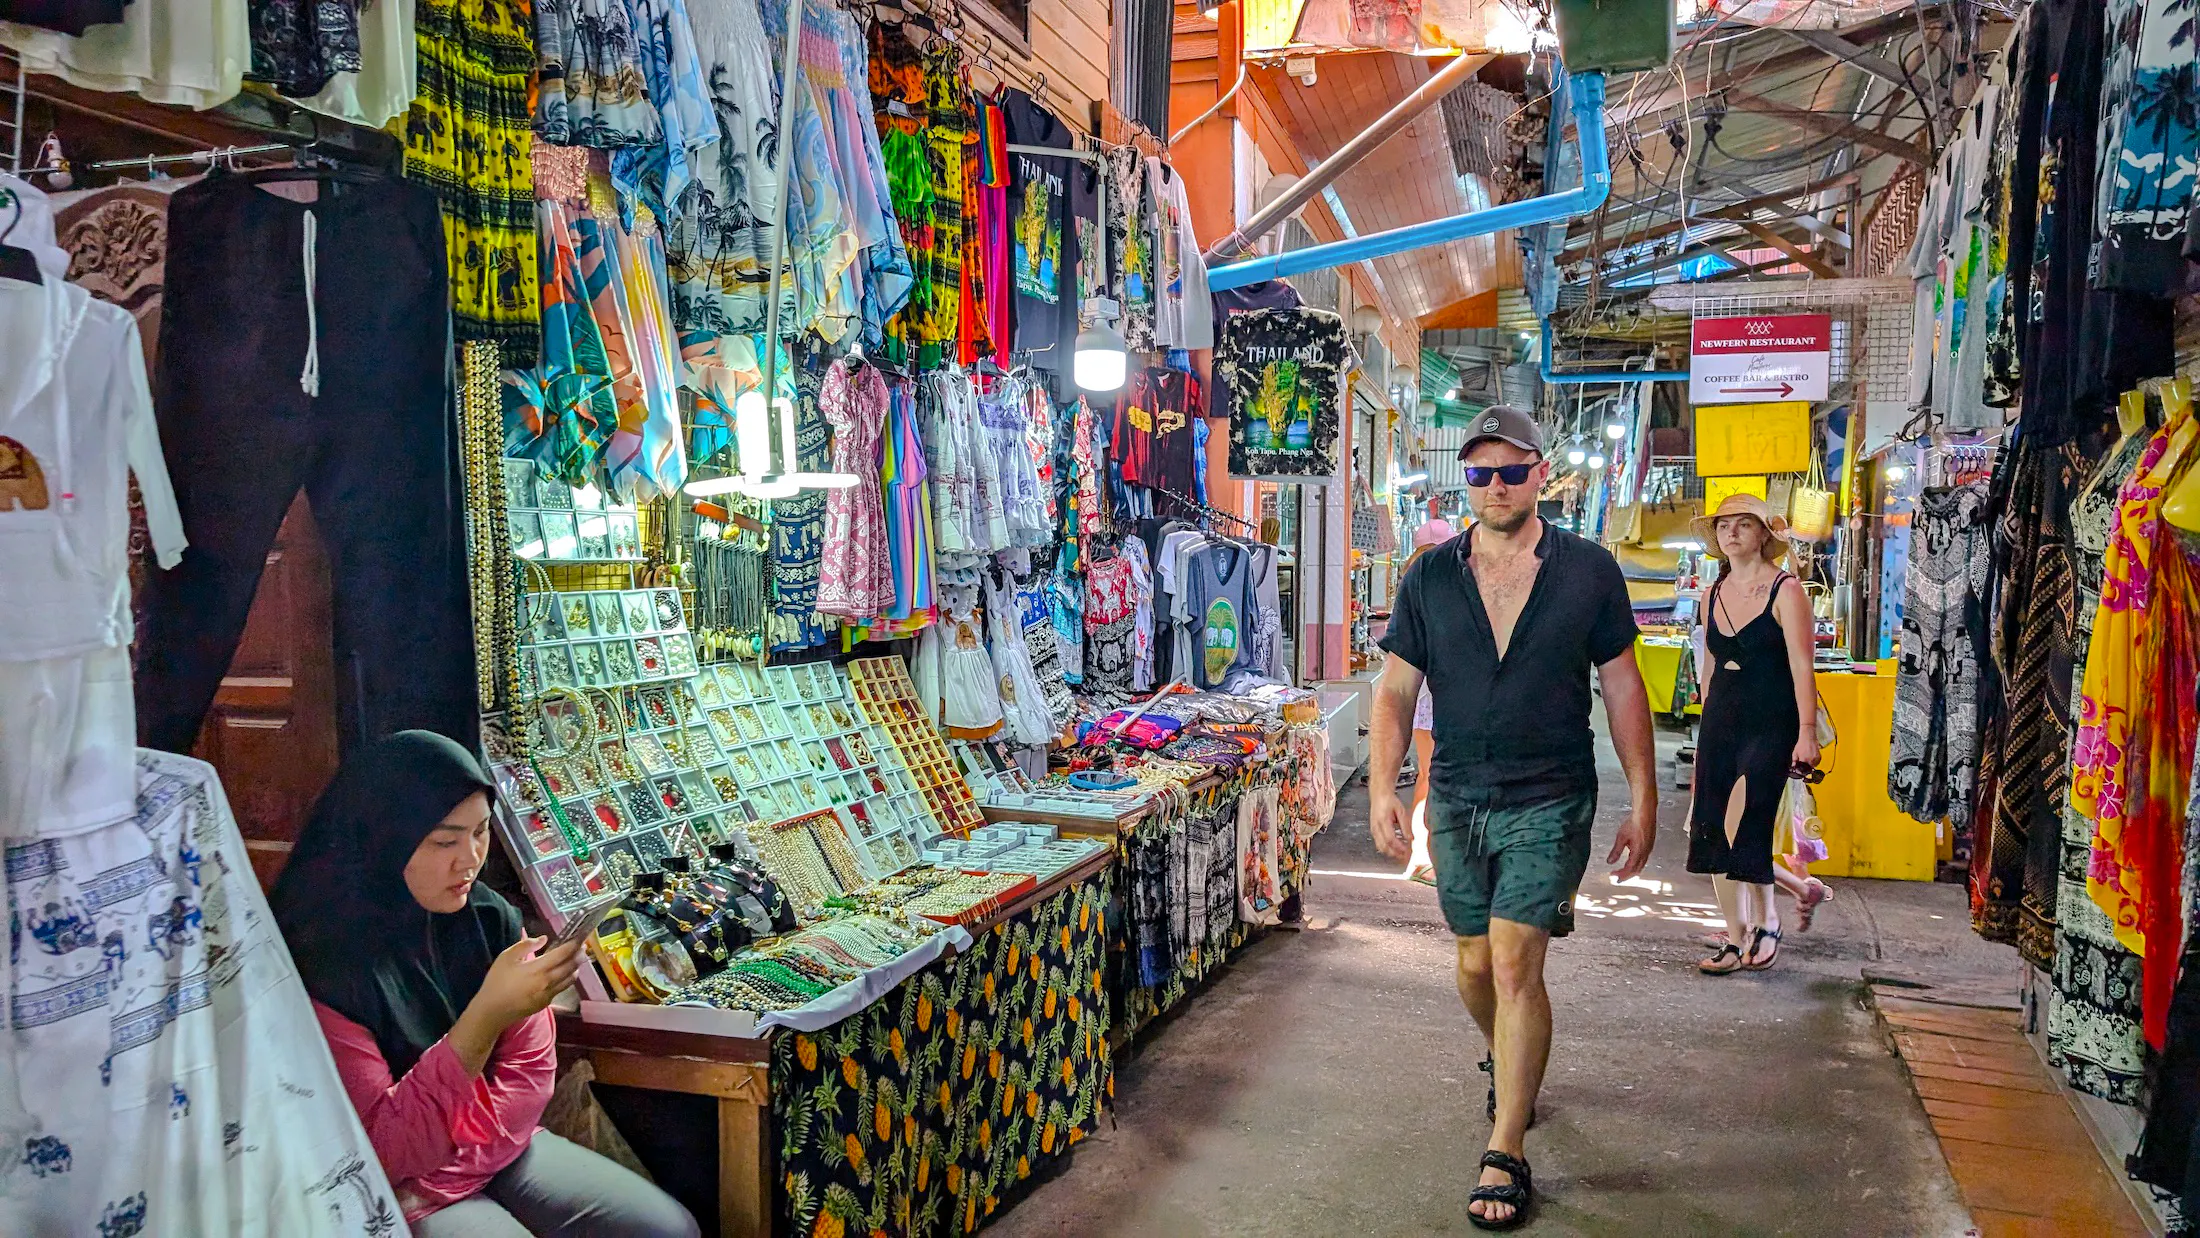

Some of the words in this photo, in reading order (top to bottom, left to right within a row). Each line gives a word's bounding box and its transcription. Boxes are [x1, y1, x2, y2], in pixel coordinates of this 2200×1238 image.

[1700, 338, 1748, 349] NEWFERN
[1749, 336, 1817, 347] RESTAURANT
[1245, 346, 1325, 364] THAILAND
[1704, 375, 1741, 383] COFFEE
[1743, 374, 1762, 382] BAR
[1764, 374, 1771, 382] &
[1774, 373, 1809, 382] BISTRO
[1244, 446, 1259, 455] Koh
[1279, 447, 1299, 457] Phang
[1300, 448, 1314, 457] Nga
